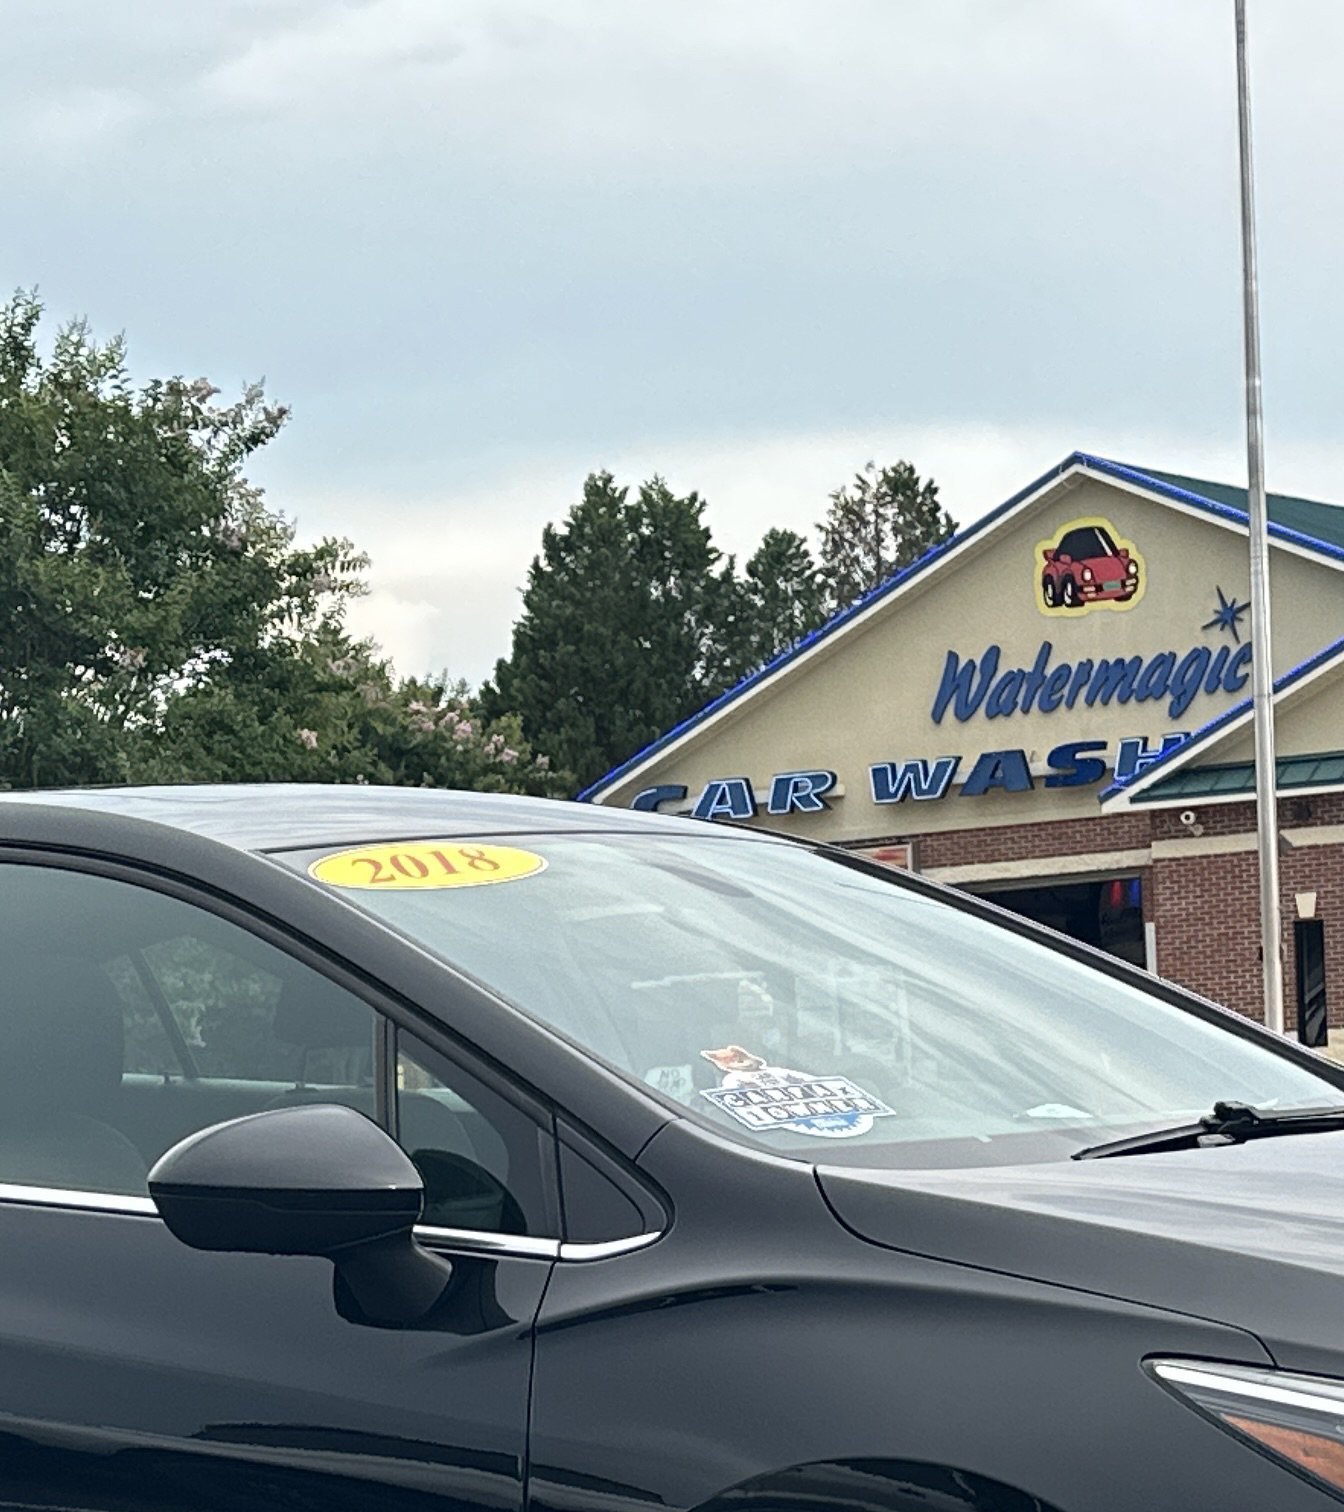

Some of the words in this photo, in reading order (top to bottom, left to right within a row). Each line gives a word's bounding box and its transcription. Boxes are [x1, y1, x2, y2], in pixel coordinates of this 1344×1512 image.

[931, 640, 1253, 724] Watermagic
[868, 731, 1191, 806] WASH
[351, 848, 502, 884] 2018
